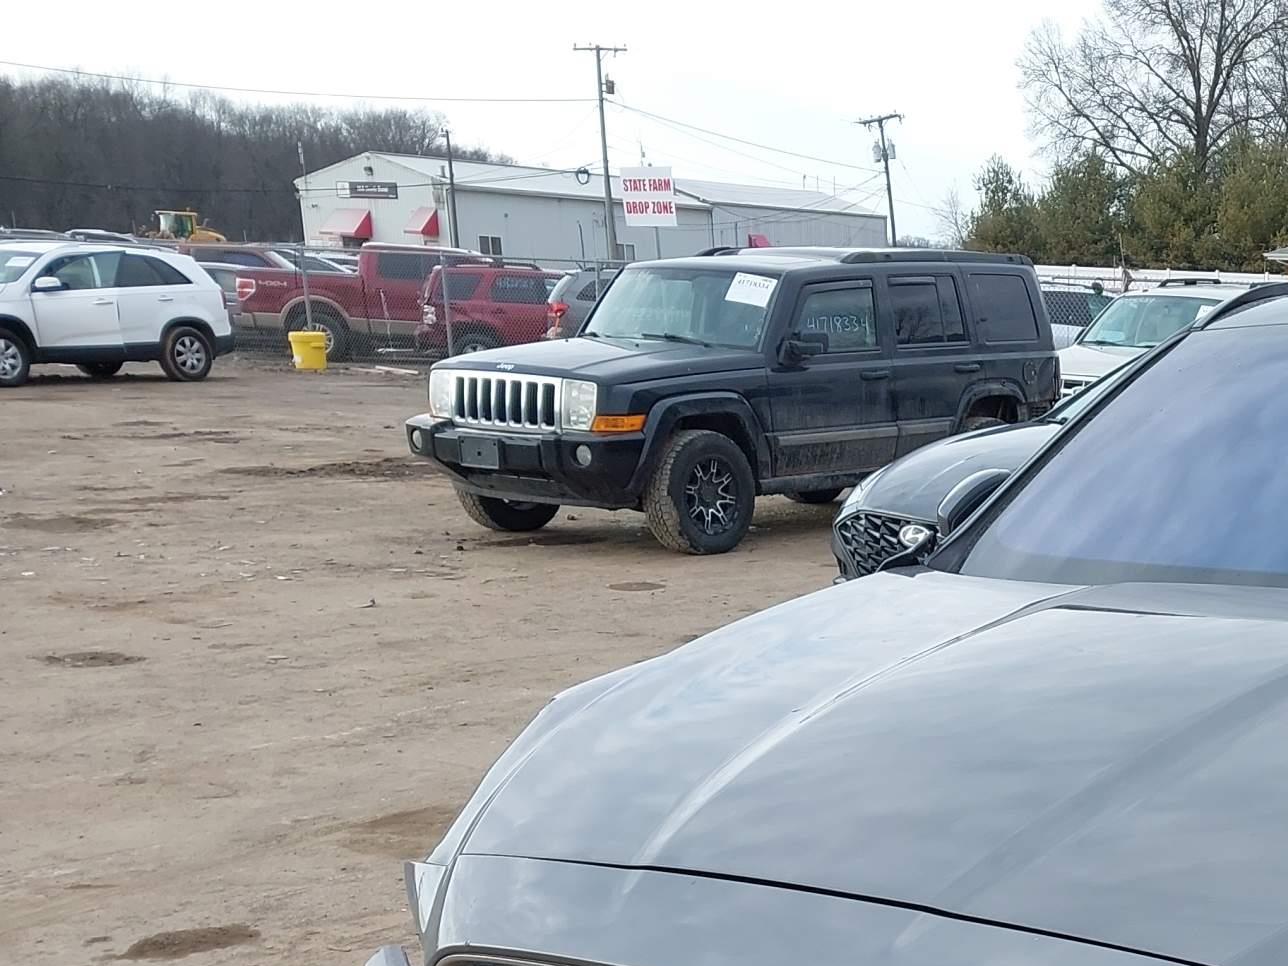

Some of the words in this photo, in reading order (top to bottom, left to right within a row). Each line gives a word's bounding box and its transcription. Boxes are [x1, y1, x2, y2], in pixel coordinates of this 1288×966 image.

[622, 178, 647, 192] STATE
[648, 178, 671, 192] FARM
[625, 201, 650, 214] DROP
[652, 201, 674, 214] ZONE
[806, 315, 870, 335] 41718334
